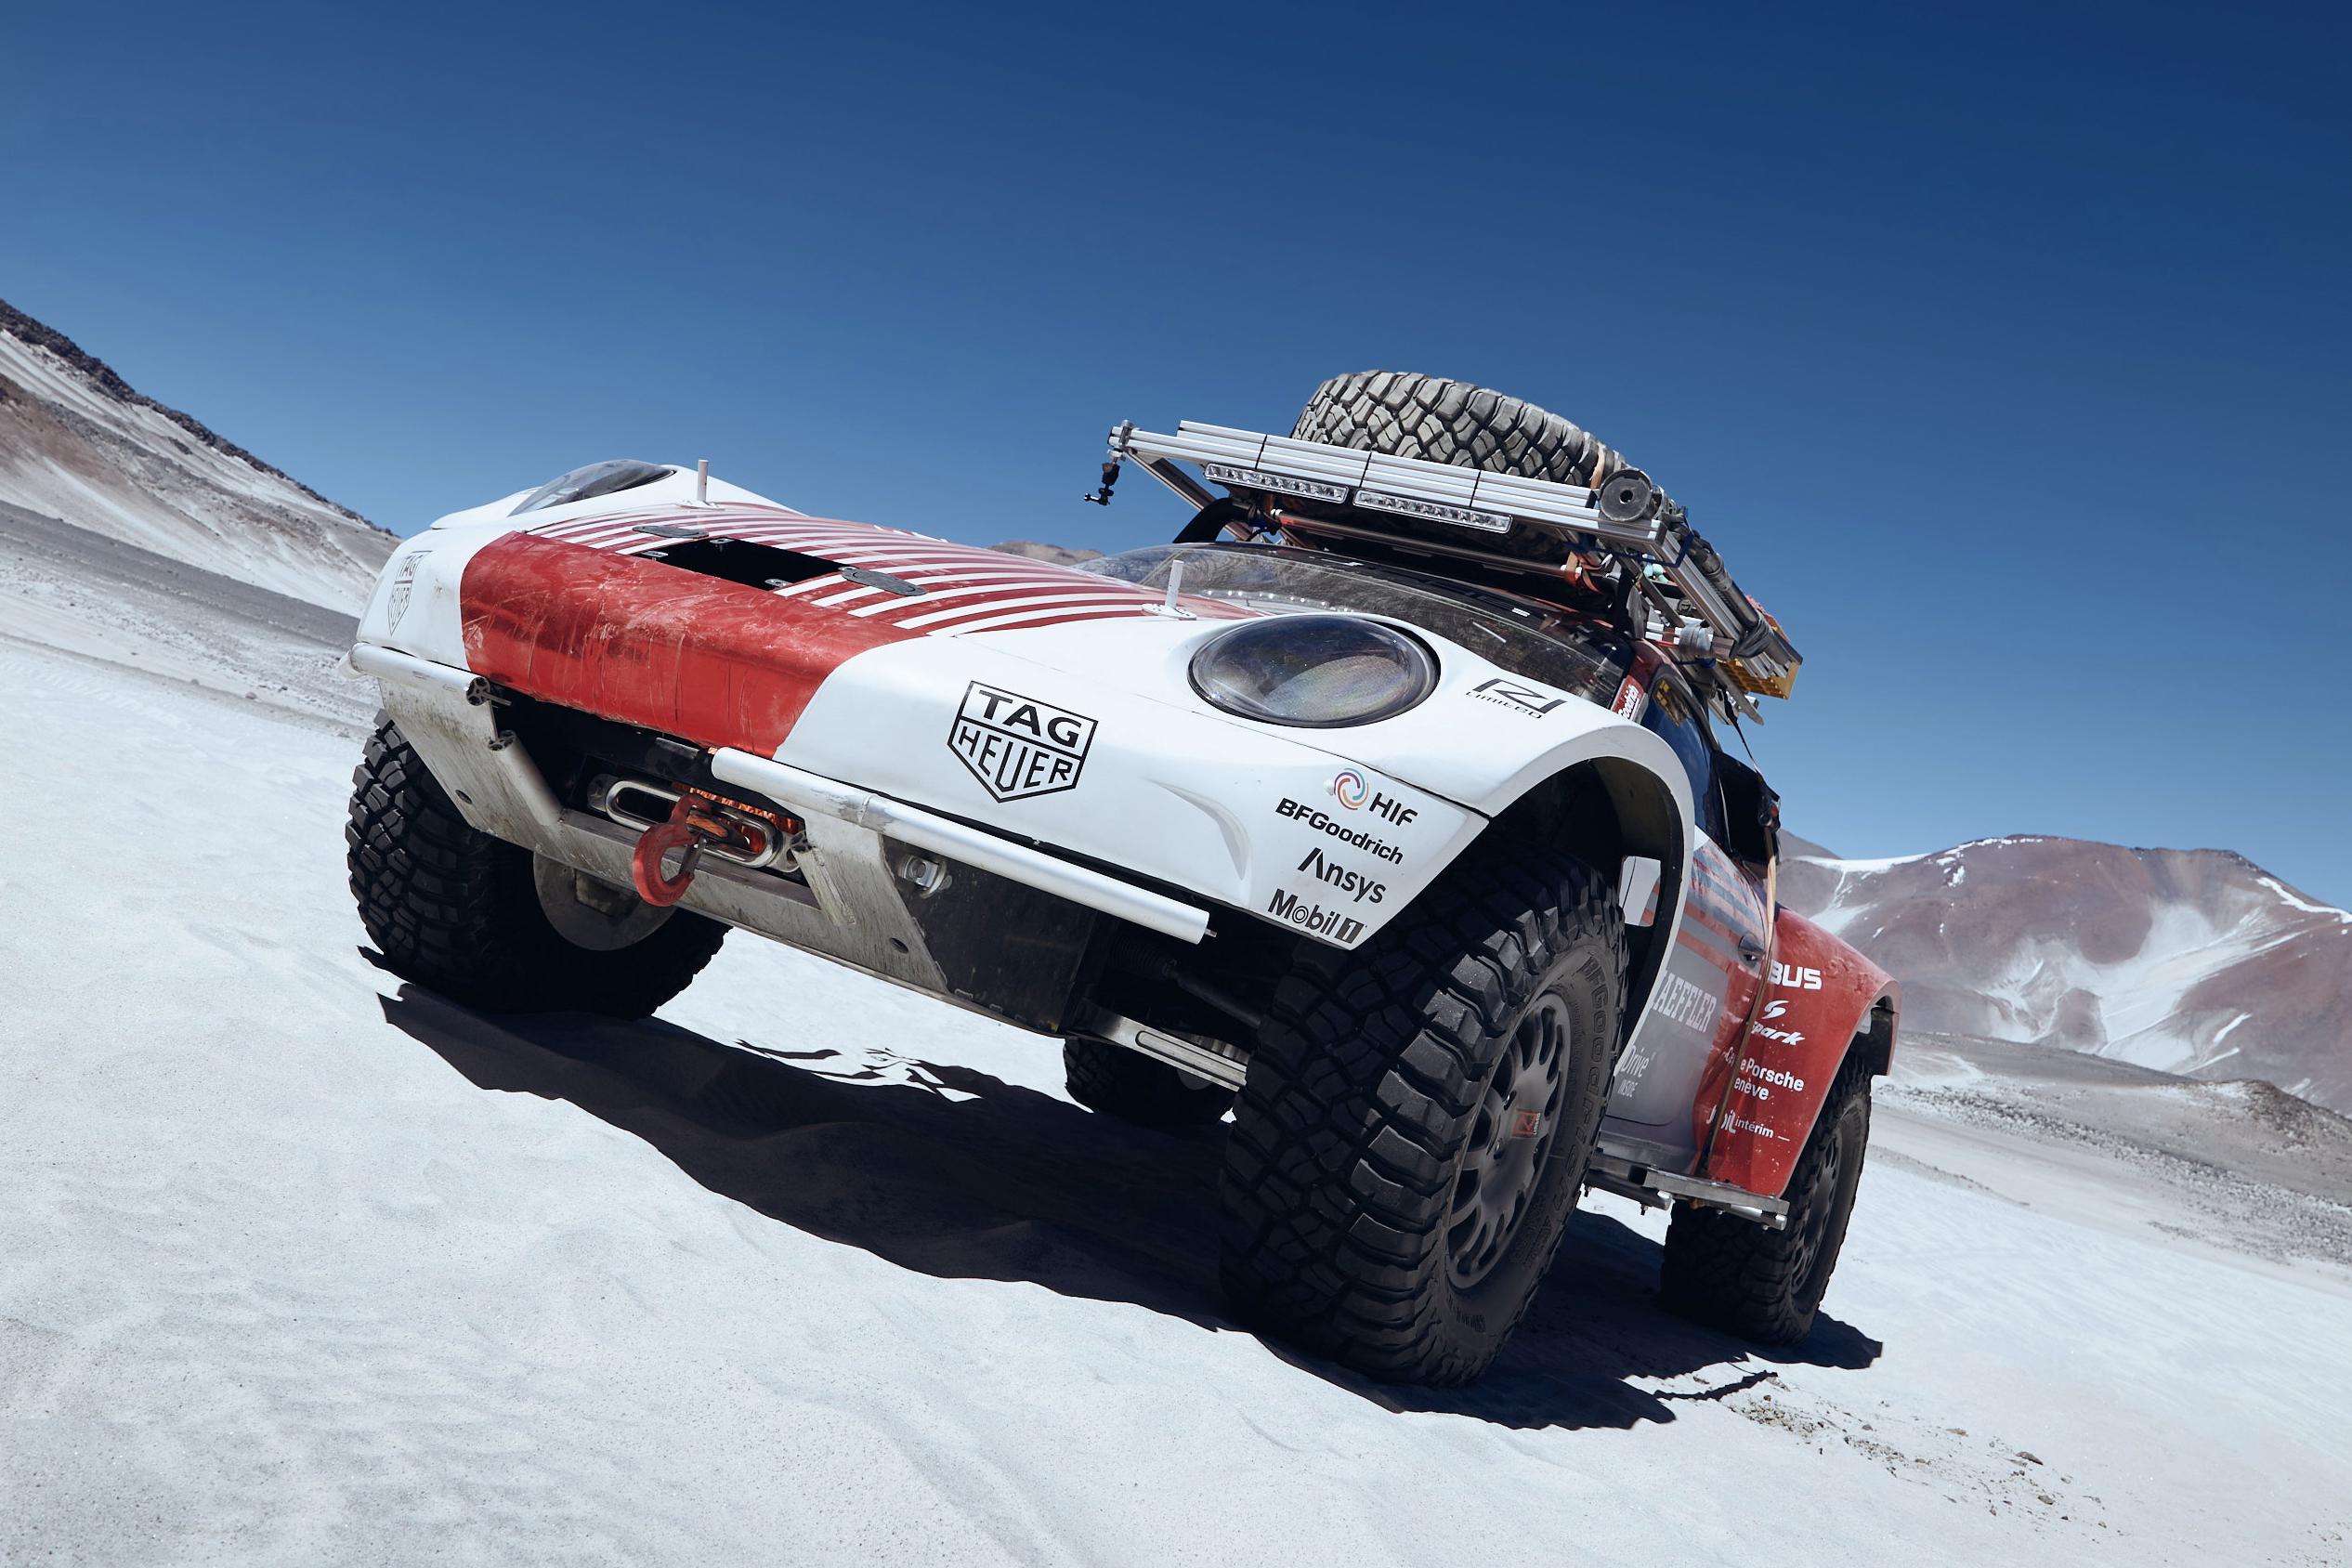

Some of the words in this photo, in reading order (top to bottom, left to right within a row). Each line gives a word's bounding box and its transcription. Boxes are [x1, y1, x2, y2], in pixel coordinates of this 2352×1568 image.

[978, 689, 1082, 749] TAG
[958, 725, 1073, 792] HEUER
[1274, 797, 1404, 865] BFGoodrich
[1368, 791, 1418, 827] HIF
[1297, 846, 1387, 904] Ansys
[1267, 888, 1340, 936] Mobil
[1767, 958, 1822, 990] BUS
[1733, 1077, 1770, 1101] enève
[1744, 1057, 1805, 1091] Porsche
